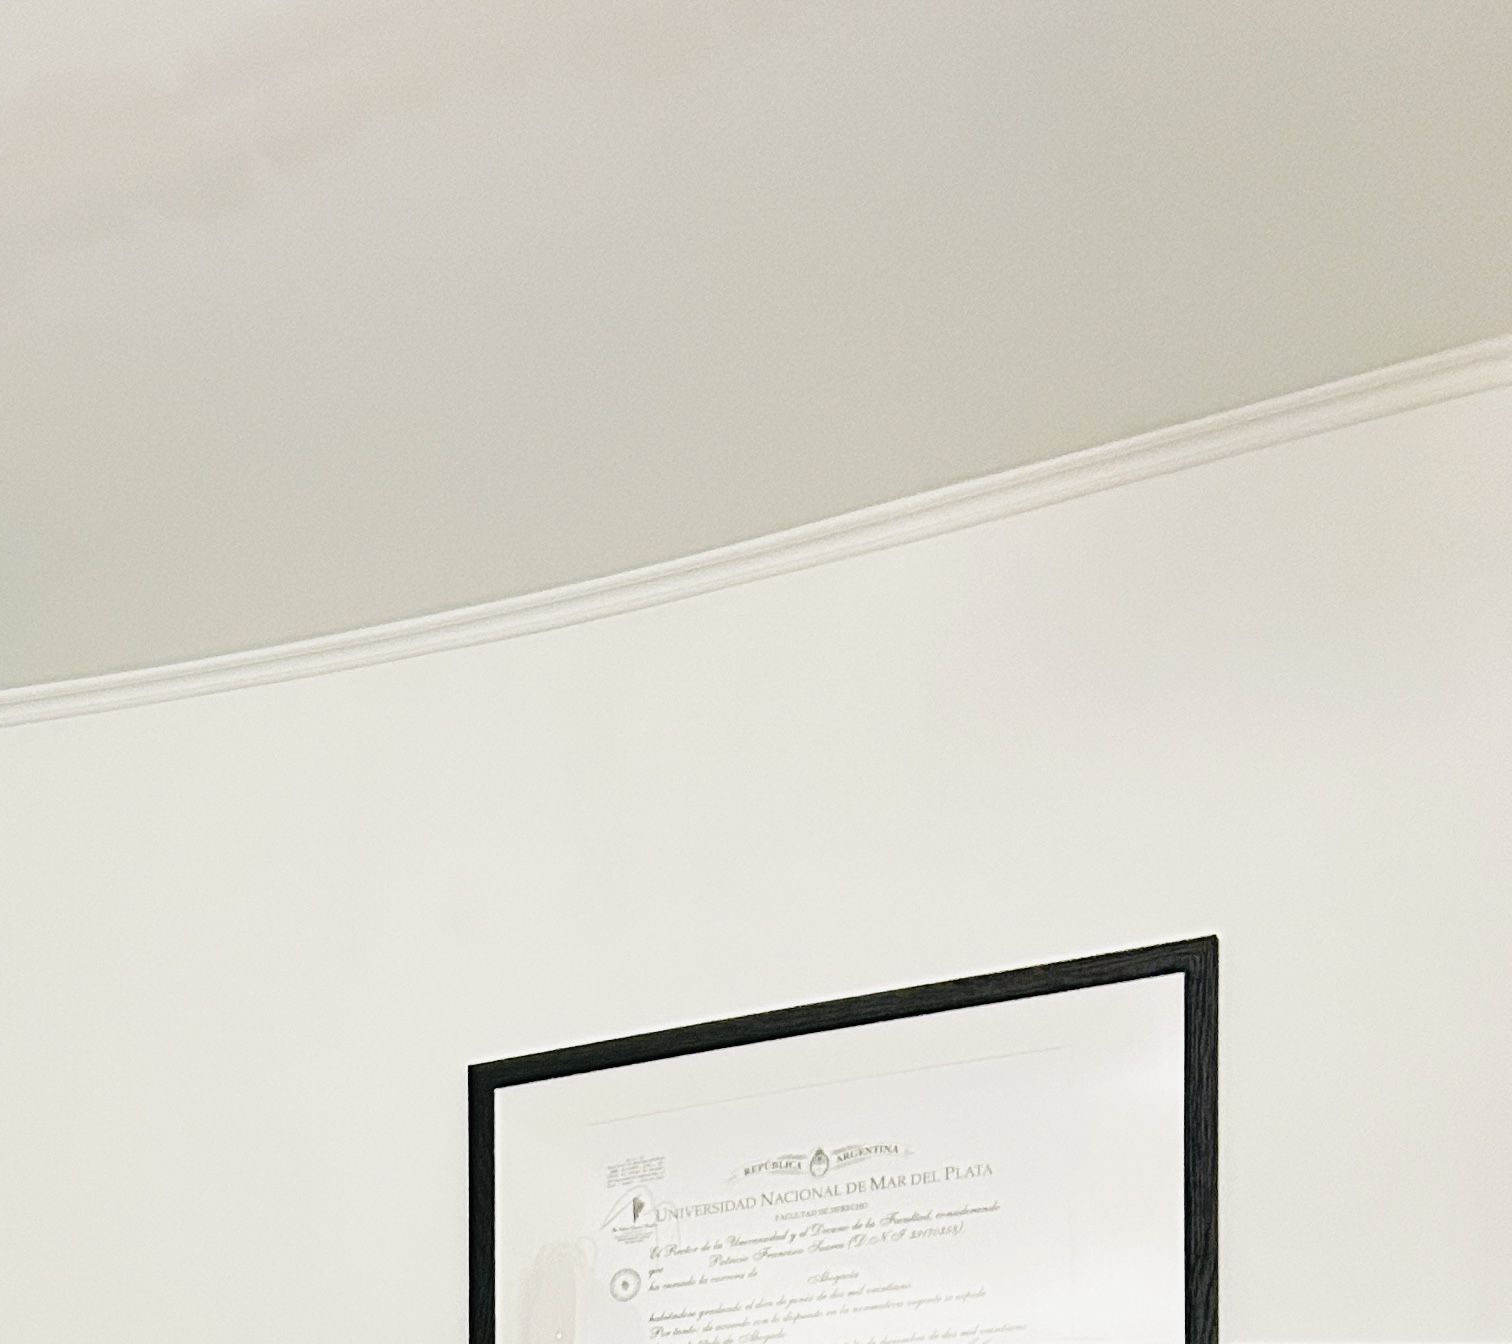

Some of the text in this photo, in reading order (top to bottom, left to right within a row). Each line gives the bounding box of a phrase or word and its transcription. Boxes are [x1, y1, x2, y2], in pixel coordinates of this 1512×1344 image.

[837, 1143, 900, 1162] ARGENTINA
[655, 1163, 994, 1222] UNIVERSIDAD NACIONAL DE MAR DEL PLATA
